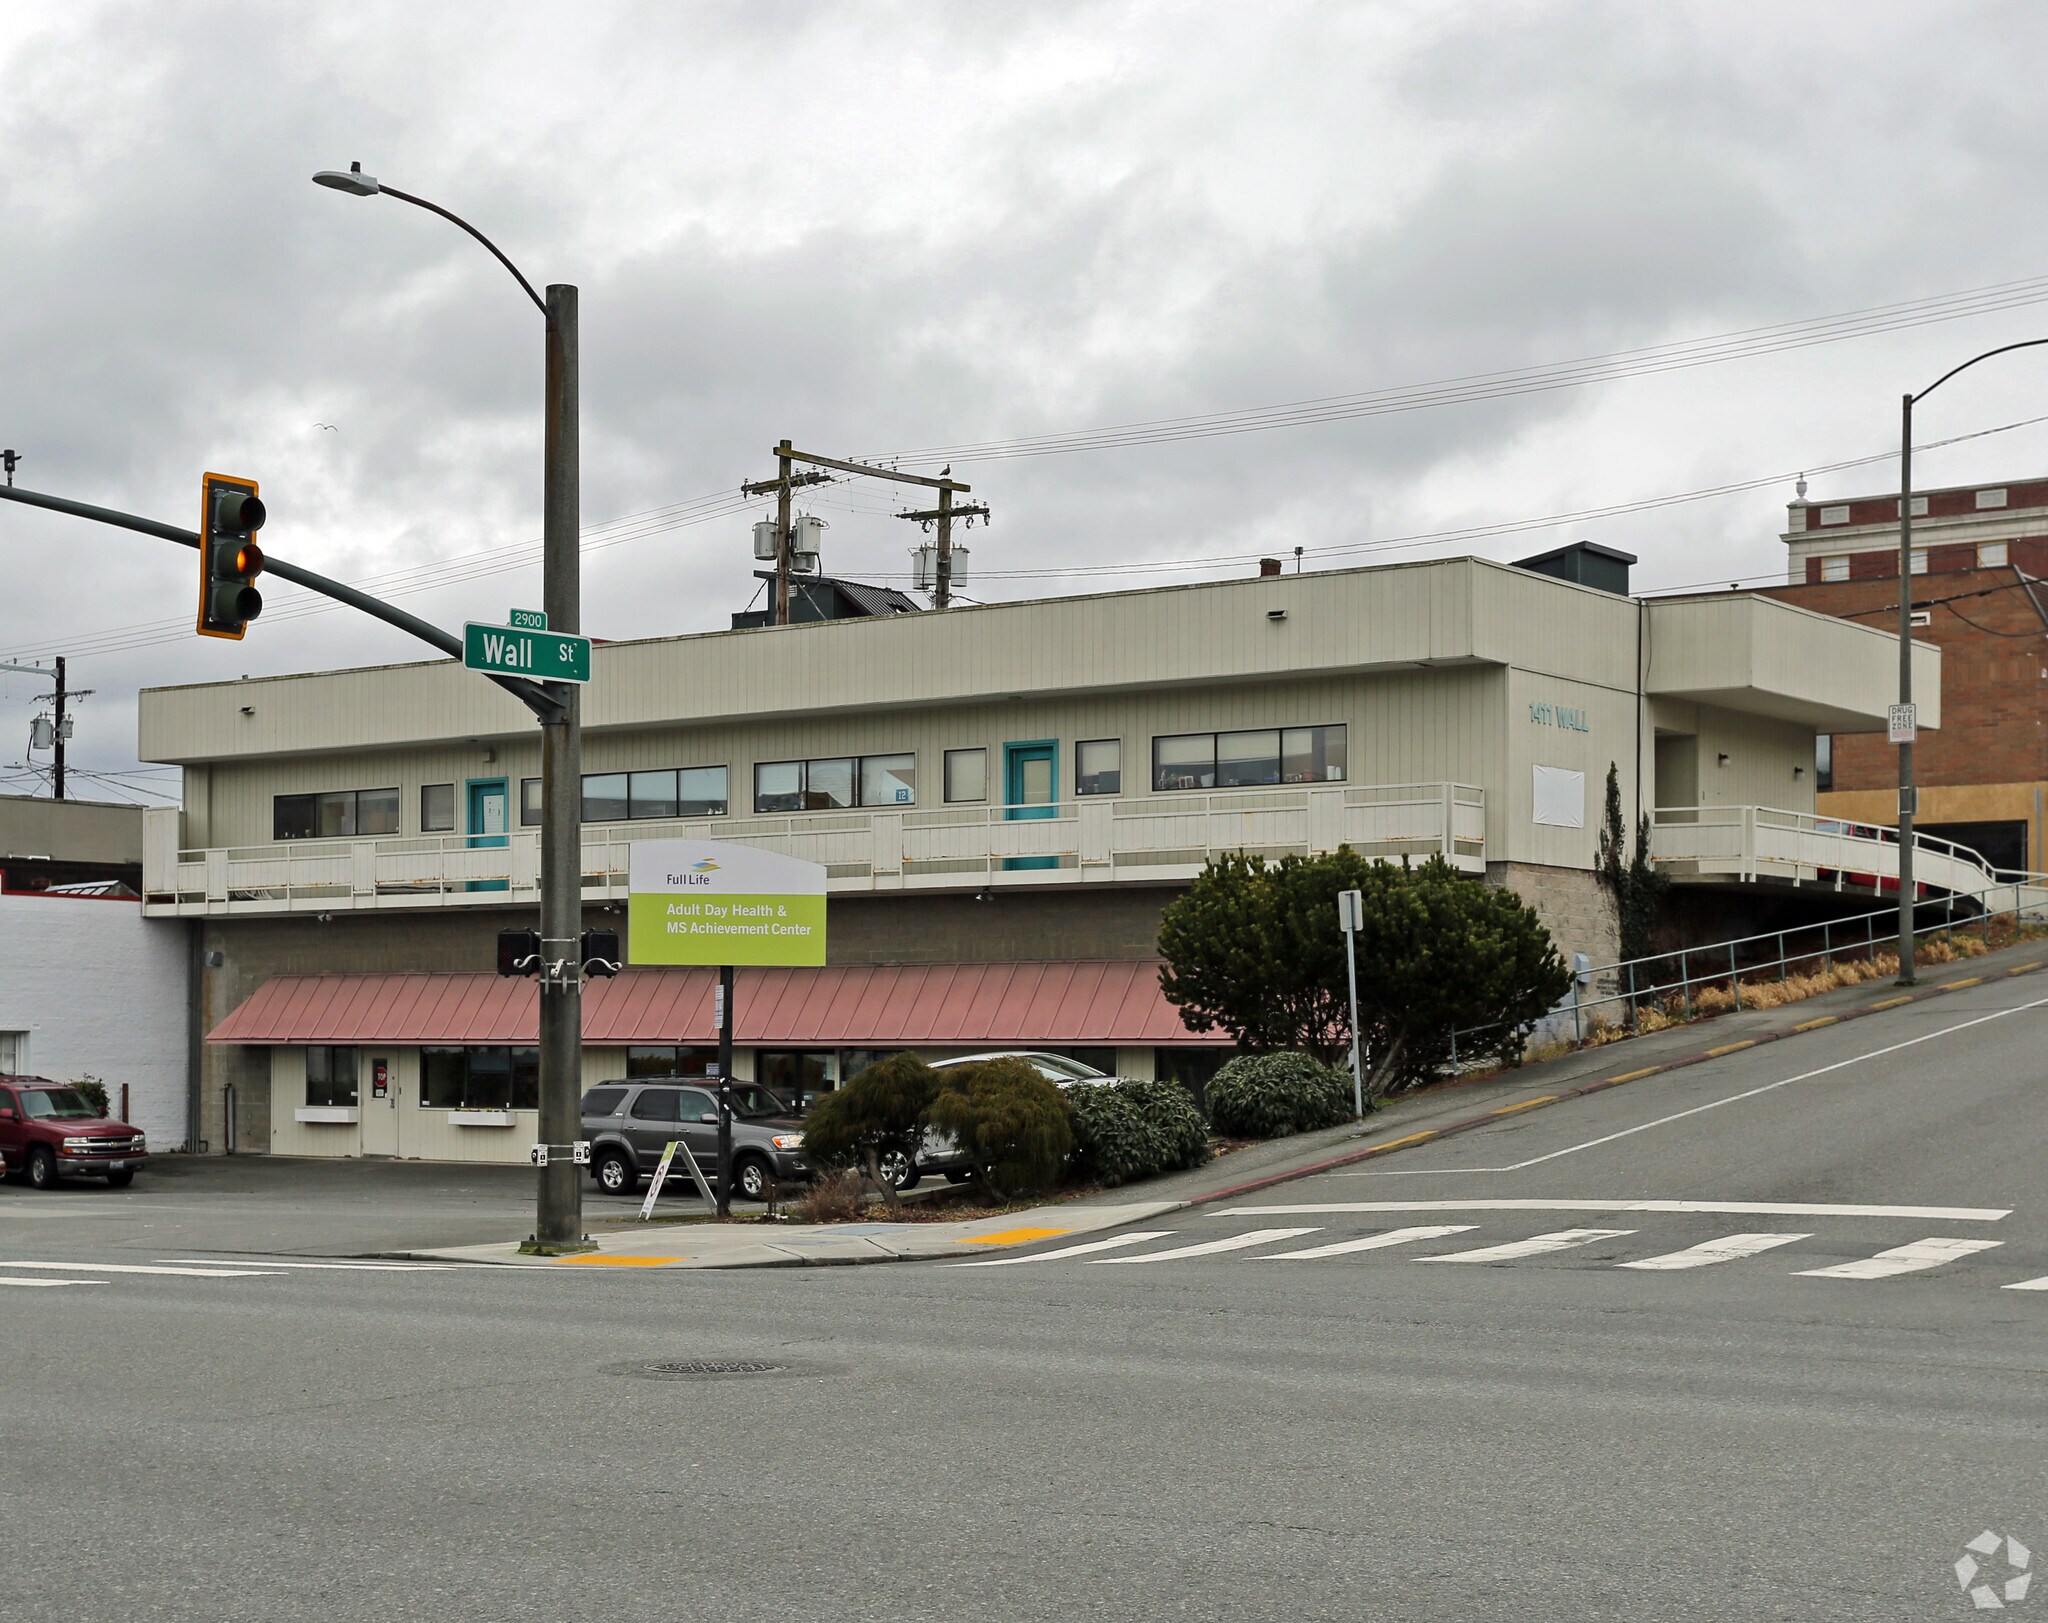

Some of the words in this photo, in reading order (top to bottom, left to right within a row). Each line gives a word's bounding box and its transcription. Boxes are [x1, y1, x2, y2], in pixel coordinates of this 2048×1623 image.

[515, 612, 542, 628] 2900
[483, 633, 532, 668] Wall
[559, 643, 574, 663] St
[1891, 706, 1913, 714] DRUG
[1555, 705, 1589, 733] WALL
[1891, 714, 1912, 722] FREE
[1892, 722, 1912, 730] ZONE
[666, 874, 687, 885] Full
[688, 874, 710, 885] Life
[666, 903, 701, 916] Adult
[705, 905, 728, 919] Day
[732, 904, 773, 917] Health
[777, 905, 788, 917] &
[666, 921, 687, 934] MS
[690, 921, 769, 935] Achievement
[771, 922, 812, 936] Center
